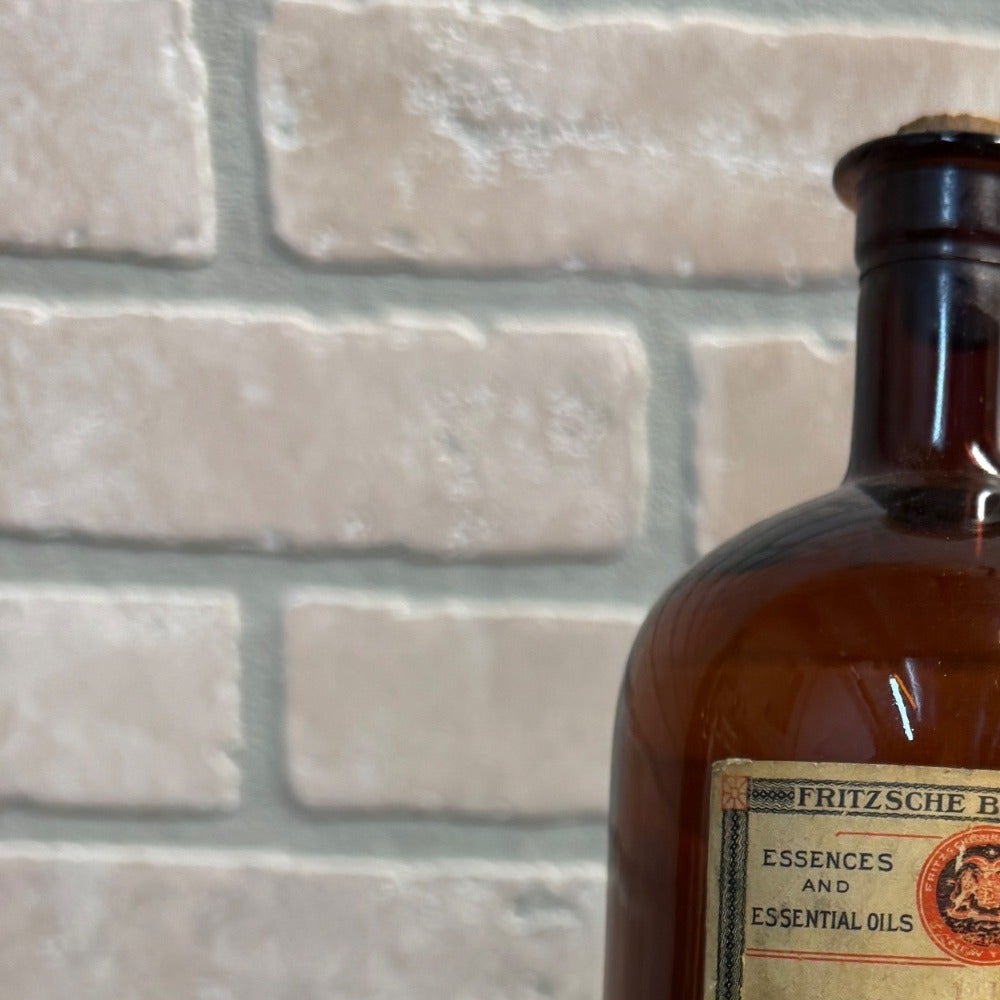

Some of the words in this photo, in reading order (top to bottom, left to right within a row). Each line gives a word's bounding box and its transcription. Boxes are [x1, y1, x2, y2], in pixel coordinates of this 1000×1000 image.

[796, 786, 966, 814] FRITZSCHE
[762, 849, 894, 873] ESSENCES
[801, 879, 850, 893] AND
[751, 907, 863, 931] ESSENTIAL
[867, 912, 914, 933] OILS
